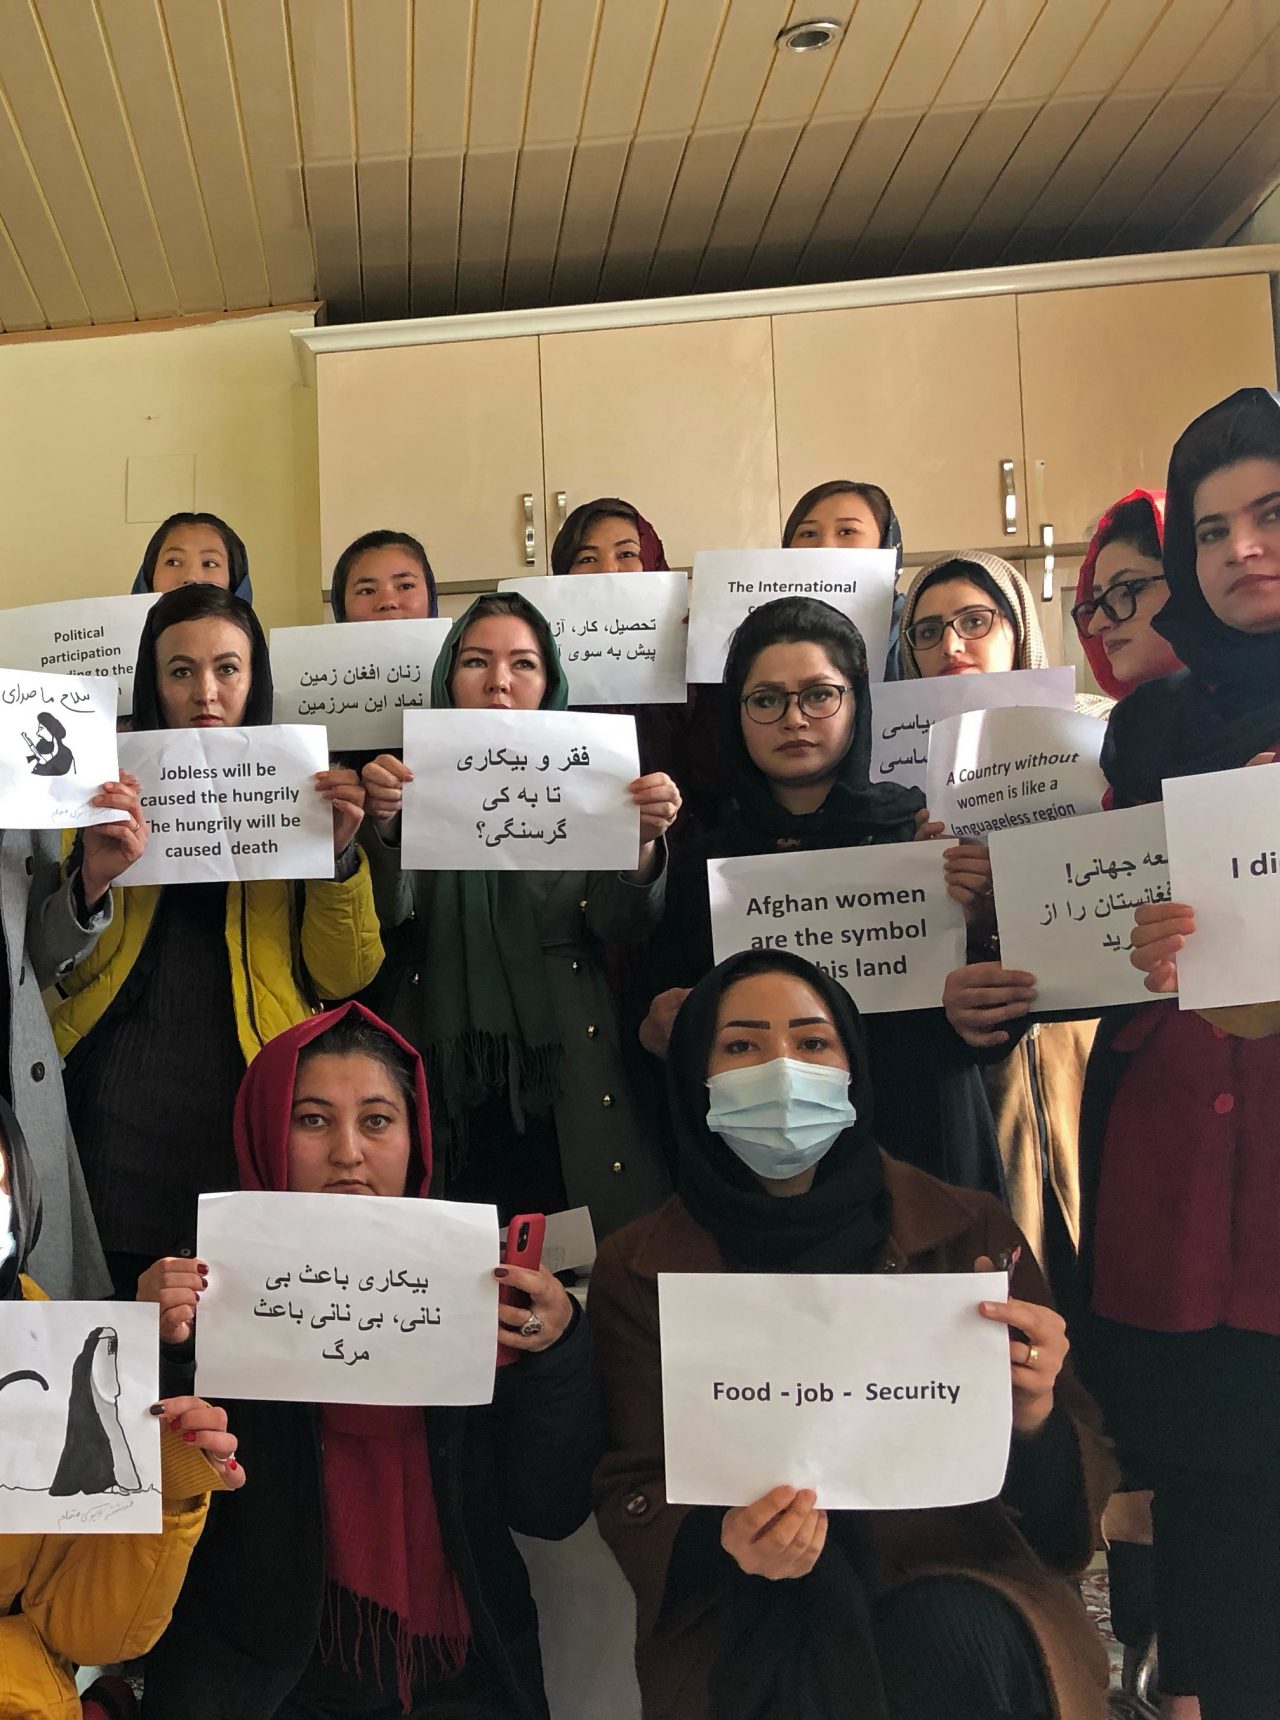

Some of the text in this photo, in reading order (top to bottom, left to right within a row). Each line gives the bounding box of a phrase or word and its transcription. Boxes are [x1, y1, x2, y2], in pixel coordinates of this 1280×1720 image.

[727, 579, 857, 594] The International
[54, 626, 104, 643] Political
[571, 620, 599, 637] کار،
[605, 619, 656, 635] تحصیل،
[41, 646, 121, 668] participation
[567, 649, 603, 662] سوی
[606, 645, 622, 661] به
[627, 643, 656, 661] پیش
[94, 667, 110, 677] to
[111, 663, 134, 676] the
[300, 664, 420, 686] زنان افغان زمین
[2, 684, 36, 704] صدای
[41, 687, 54, 703] ما
[298, 692, 423, 715] نماد این سرزمین
[457, 746, 589, 771] فقر و بیکاری
[945, 752, 1079, 787] A Country without
[159, 762, 277, 781] Jobless will be
[140, 786, 299, 807] caused the hungrily
[483, 786, 560, 811] تا به کی
[957, 779, 1058, 809] women is like a
[176, 816, 242, 833] hungrily
[246, 813, 276, 829] will
[280, 812, 301, 828] be
[951, 803, 1076, 836] languageless region
[476, 818, 566, 847] گرسنگی؟
[165, 839, 278, 858] caused death
[1066, 858, 1136, 887] جهانی!
[1232, 858, 1239, 878] I
[747, 889, 925, 918] Afghan women
[1040, 903, 1057, 926] از
[1067, 901, 1086, 921] را
[751, 919, 926, 951] are the symbol
[815, 955, 907, 980] his land
[266, 1265, 428, 1294] بیکاری باعث بی
[254, 1299, 440, 1332] نانی، بی نانی باعث
[322, 1339, 369, 1366] مرگ
[714, 1382, 770, 1401] Food
[796, 1383, 833, 1406] job
[866, 1381, 960, 1404] Security
